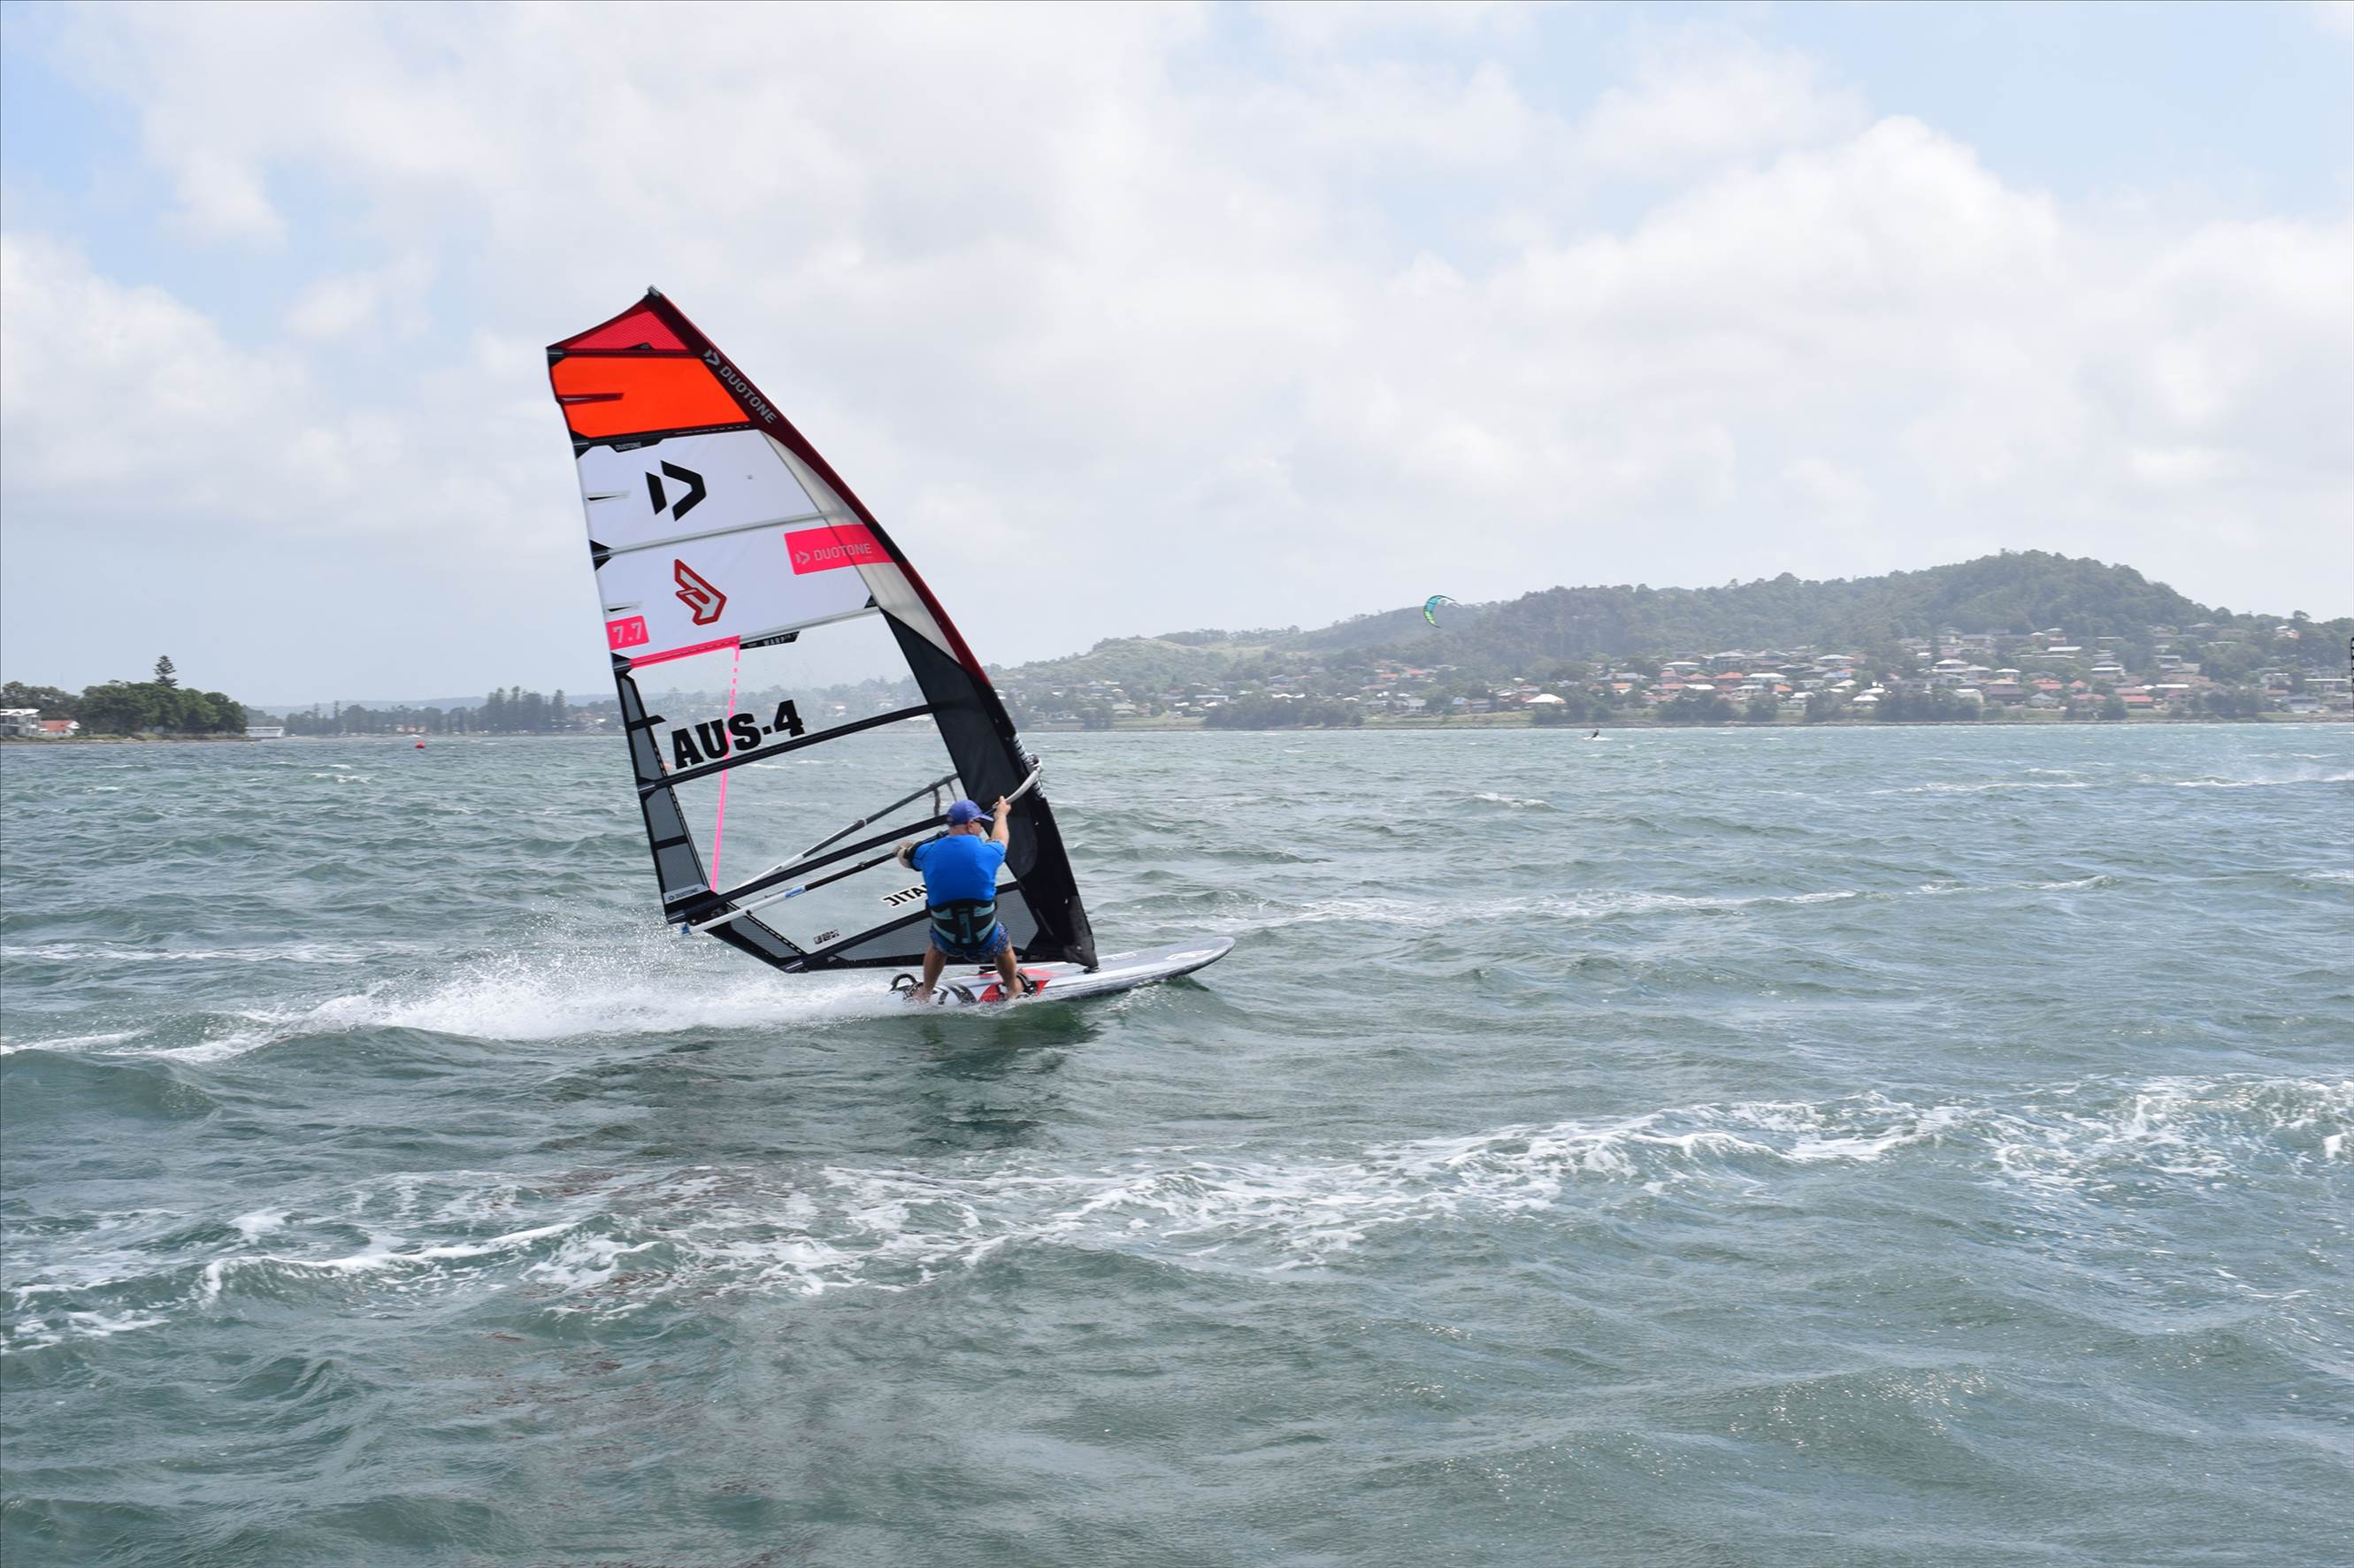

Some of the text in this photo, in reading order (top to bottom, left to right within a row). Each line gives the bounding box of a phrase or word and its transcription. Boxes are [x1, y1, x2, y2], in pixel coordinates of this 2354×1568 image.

[719, 365, 778, 425] DUOTONE
[813, 543, 873, 562] DUOTONE
[612, 622, 642, 644] 7.7
